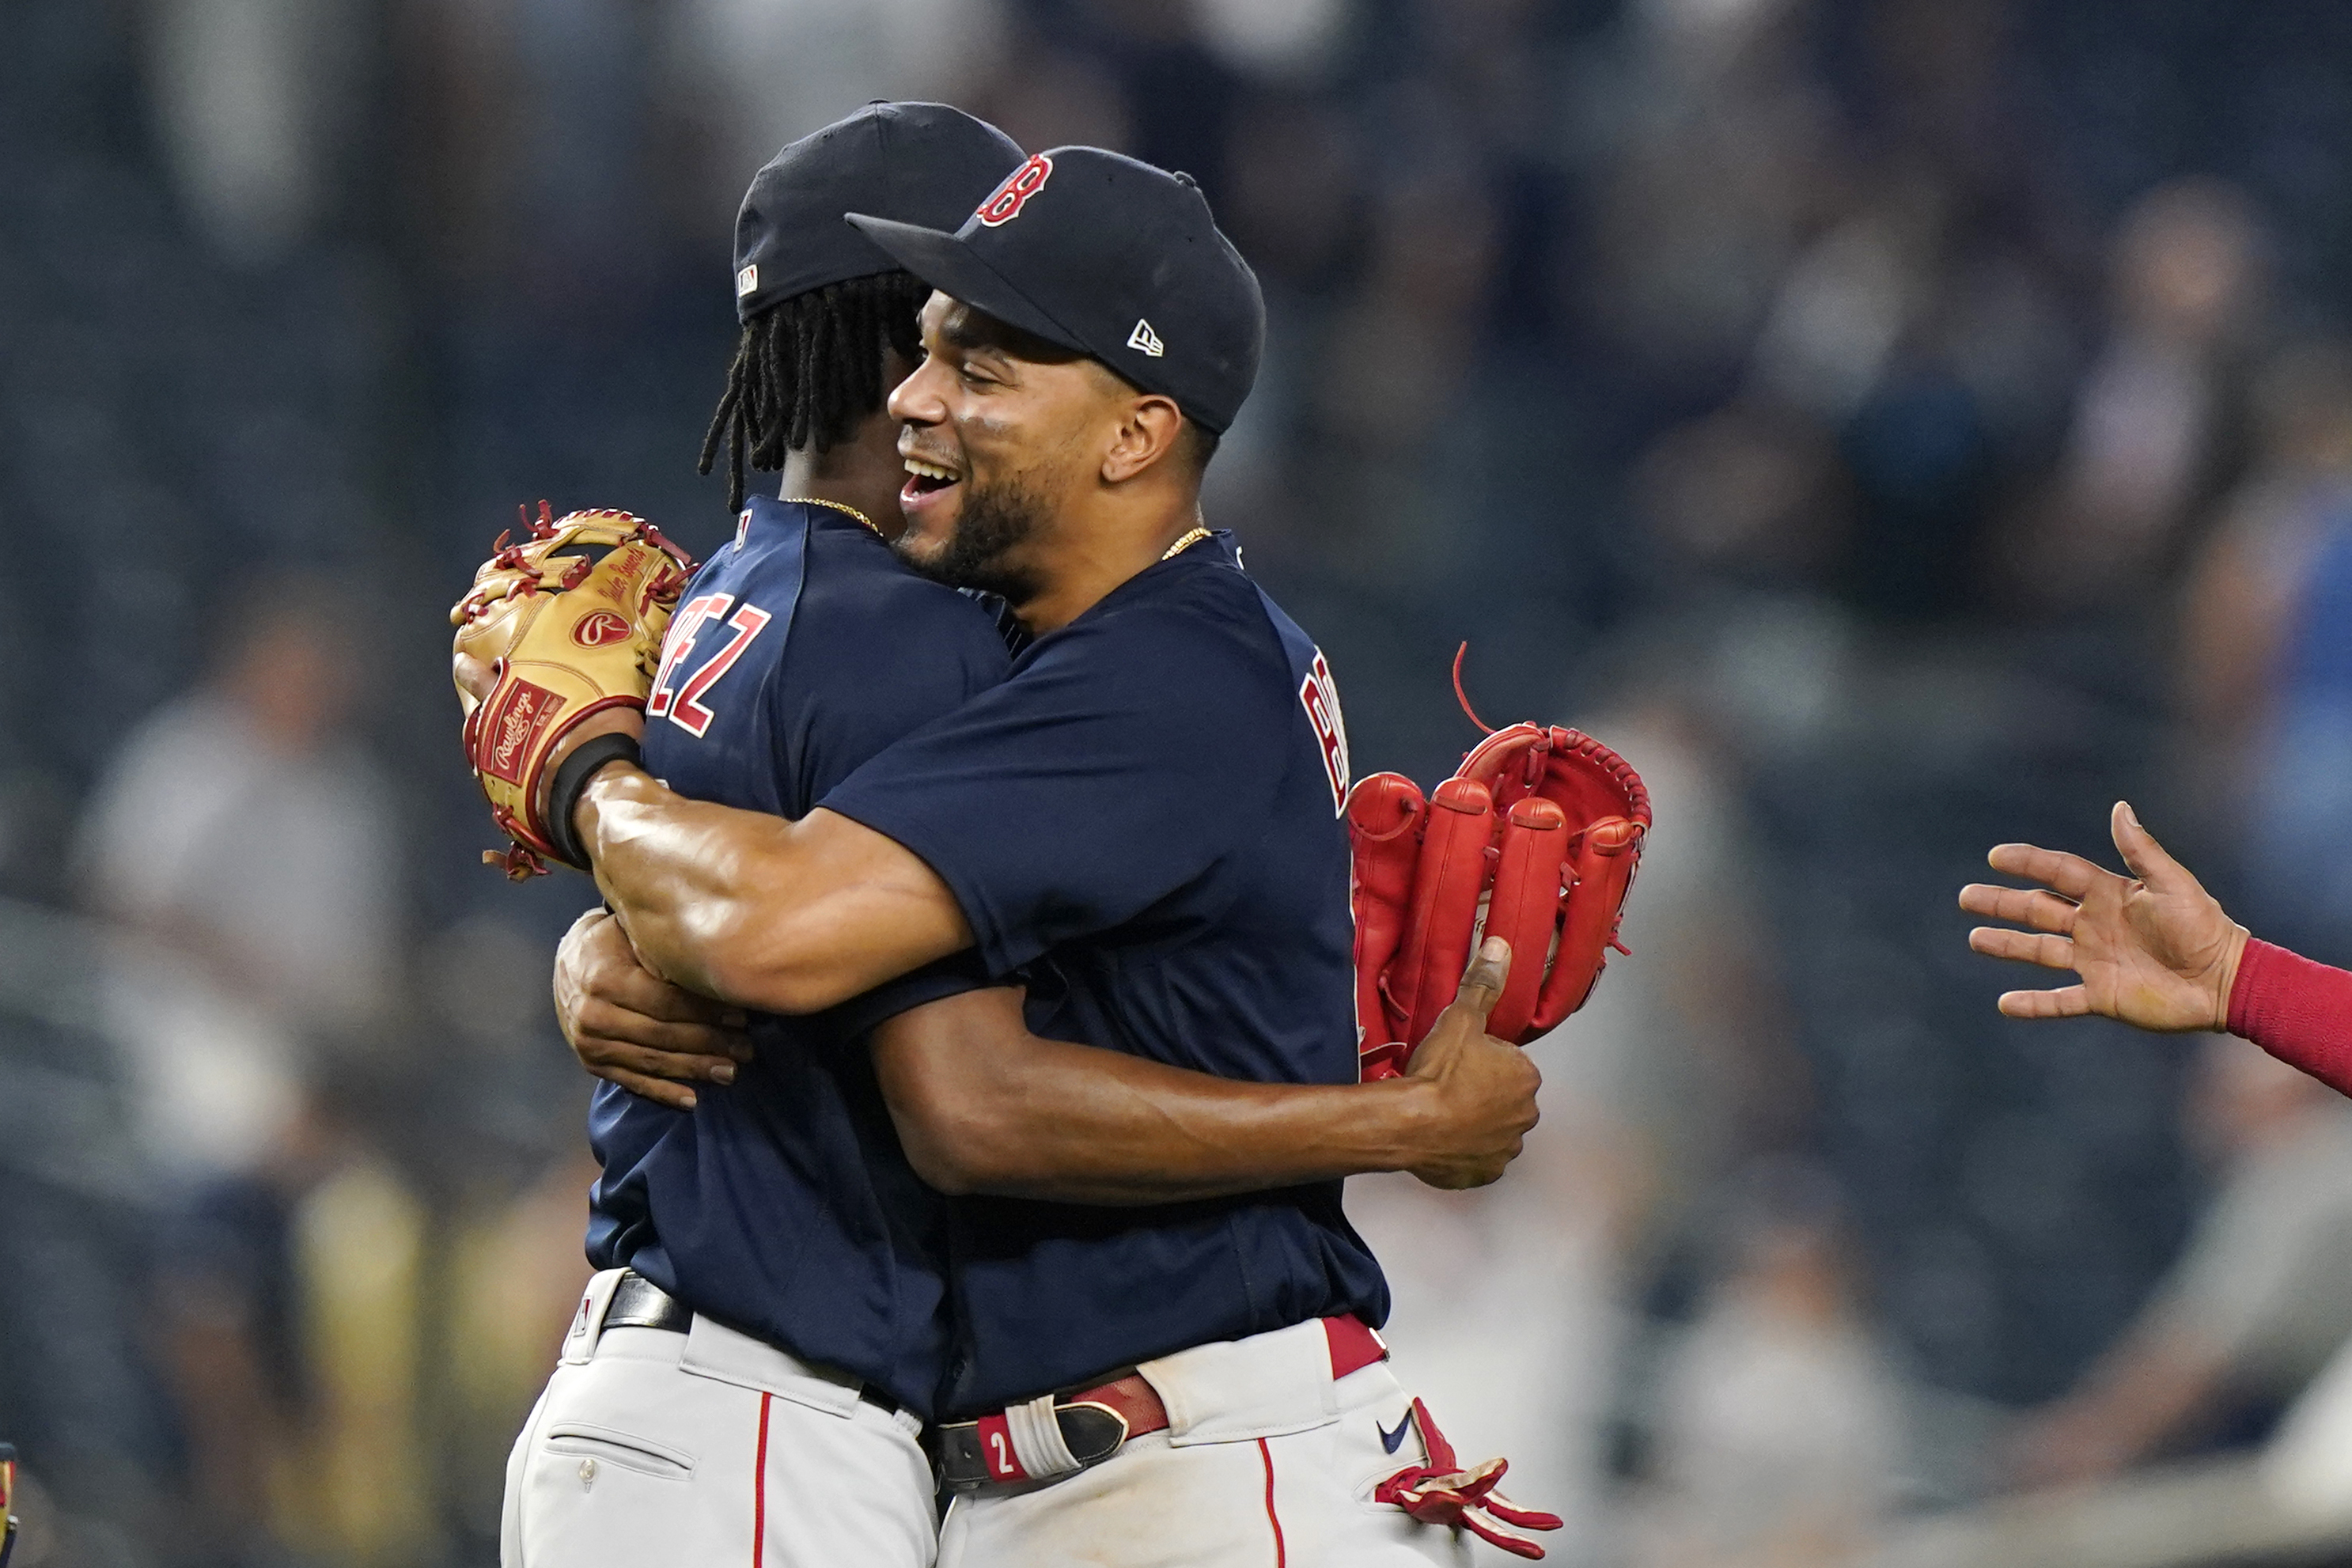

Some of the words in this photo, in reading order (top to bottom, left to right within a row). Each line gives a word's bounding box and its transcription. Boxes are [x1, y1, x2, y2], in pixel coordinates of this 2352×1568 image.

[976, 153, 1053, 227] B
[495, 691, 534, 770] Rawlings
[990, 1432, 1014, 1474] 2
